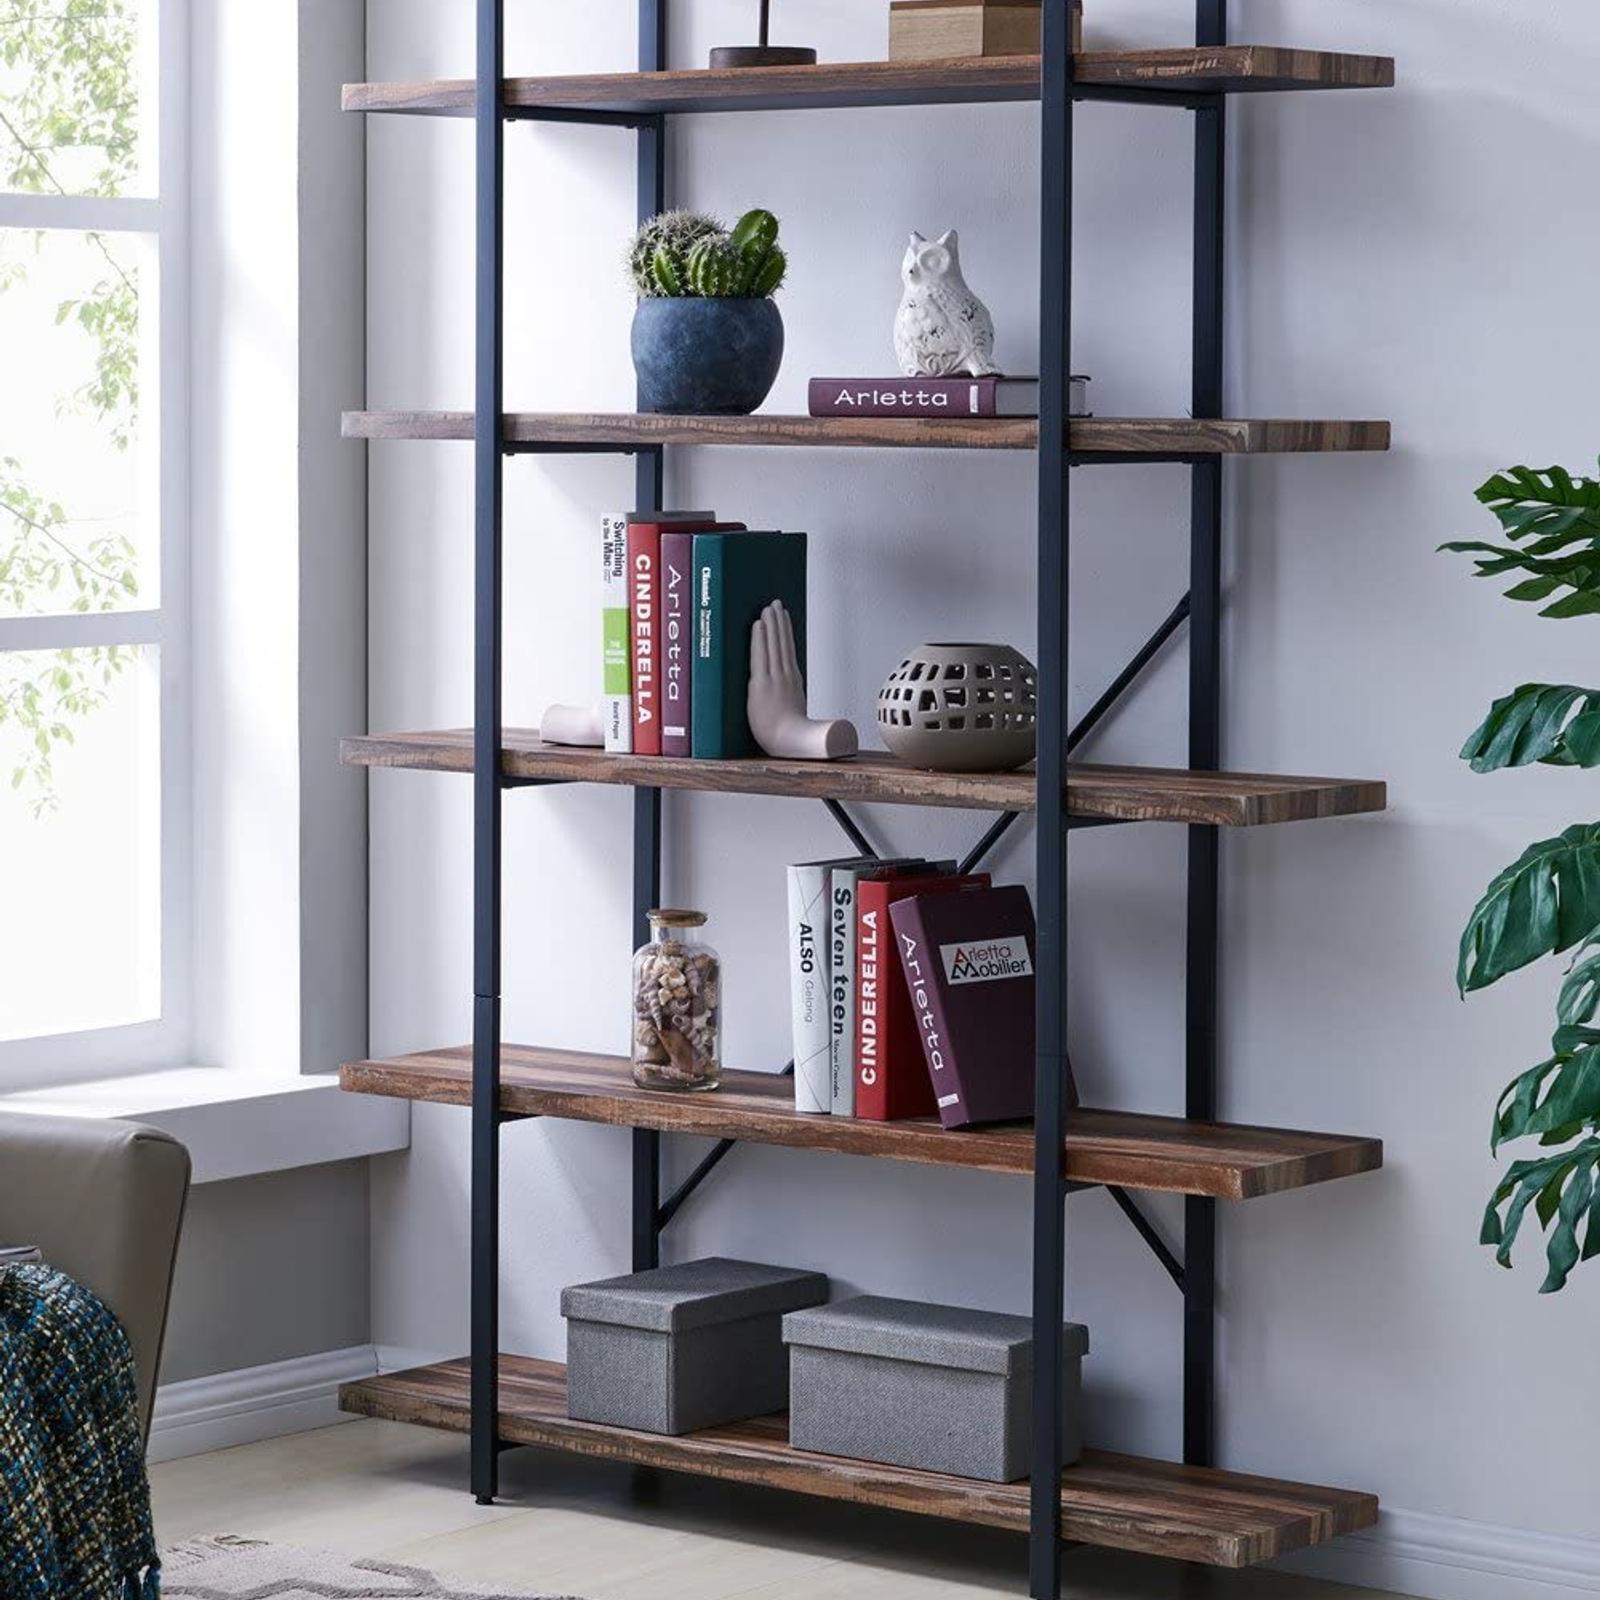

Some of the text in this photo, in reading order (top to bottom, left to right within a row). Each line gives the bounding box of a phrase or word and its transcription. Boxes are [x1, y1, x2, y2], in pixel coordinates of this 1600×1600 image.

[834, 389, 947, 406] Arletta
[603, 542, 613, 567] Mac
[612, 521, 625, 577] Switching
[634, 554, 652, 724] CINDERELLA
[668, 564, 681, 700] Arletta
[799, 923, 813, 973] ALSO
[833, 888, 851, 967] Seven
[954, 944, 1012, 964] Arletta
[950, 957, 1027, 979] Mobilier
[833, 974, 850, 1034] teen
[861, 911, 878, 1085] CINDERELLA
[902, 933, 944, 1070] Arletta
